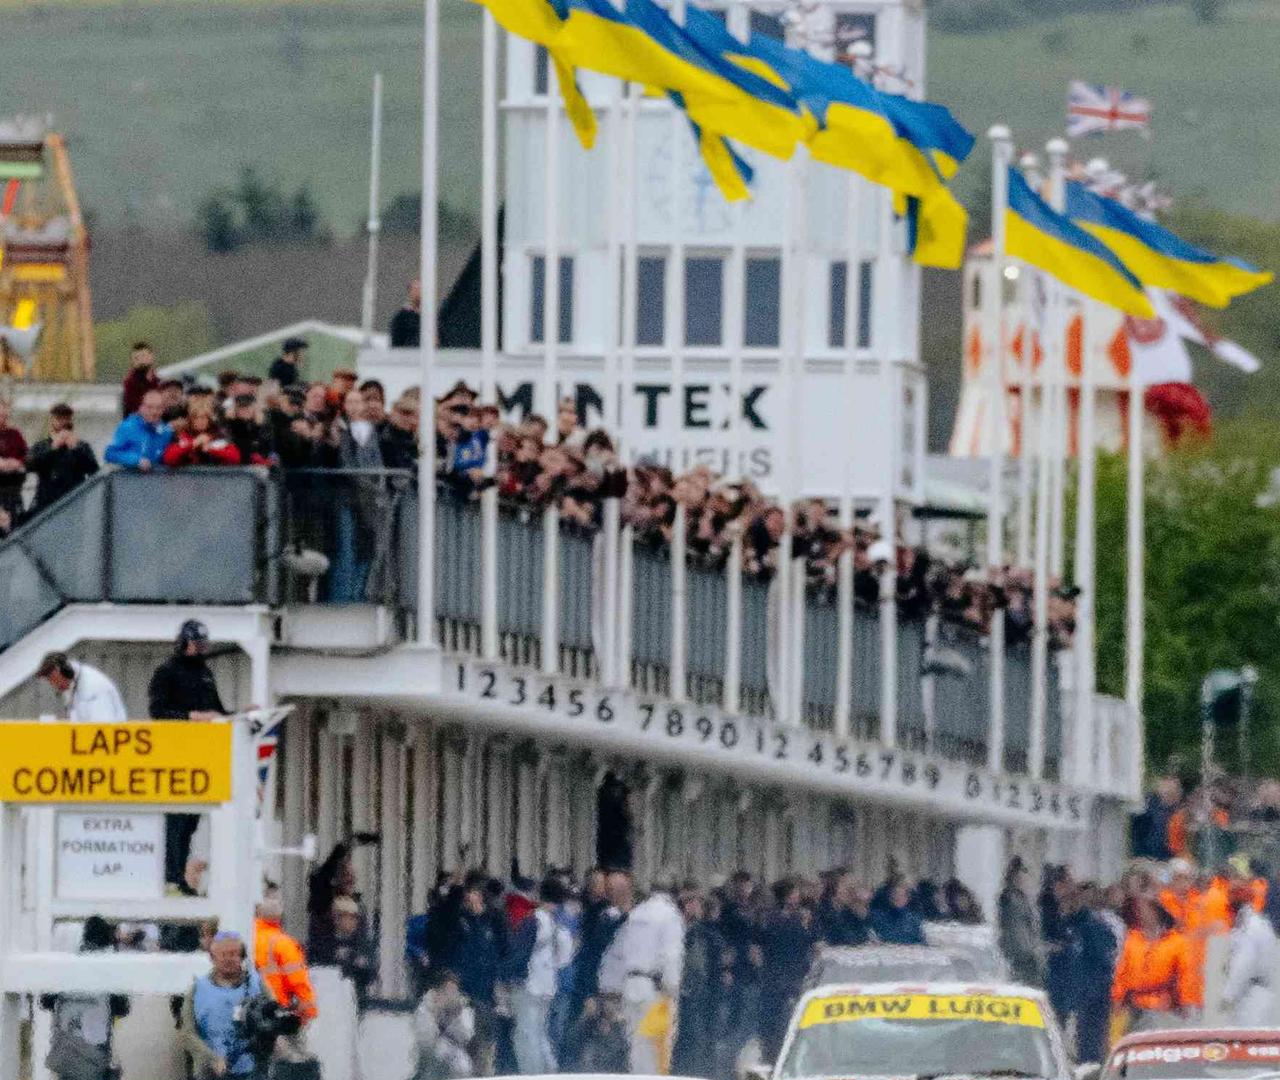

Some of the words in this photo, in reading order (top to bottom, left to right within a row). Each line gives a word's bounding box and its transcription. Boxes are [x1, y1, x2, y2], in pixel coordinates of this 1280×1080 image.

[71, 729, 152, 755] LAPS
[13, 768, 210, 796] COMPLETED
[82, 818, 133, 832] EXTRA
[62, 839, 154, 854] FORMATION
[92, 862, 123, 876] LAP
[824, 999, 912, 1017] BMW
[926, 999, 1022, 1018] LUIGI
